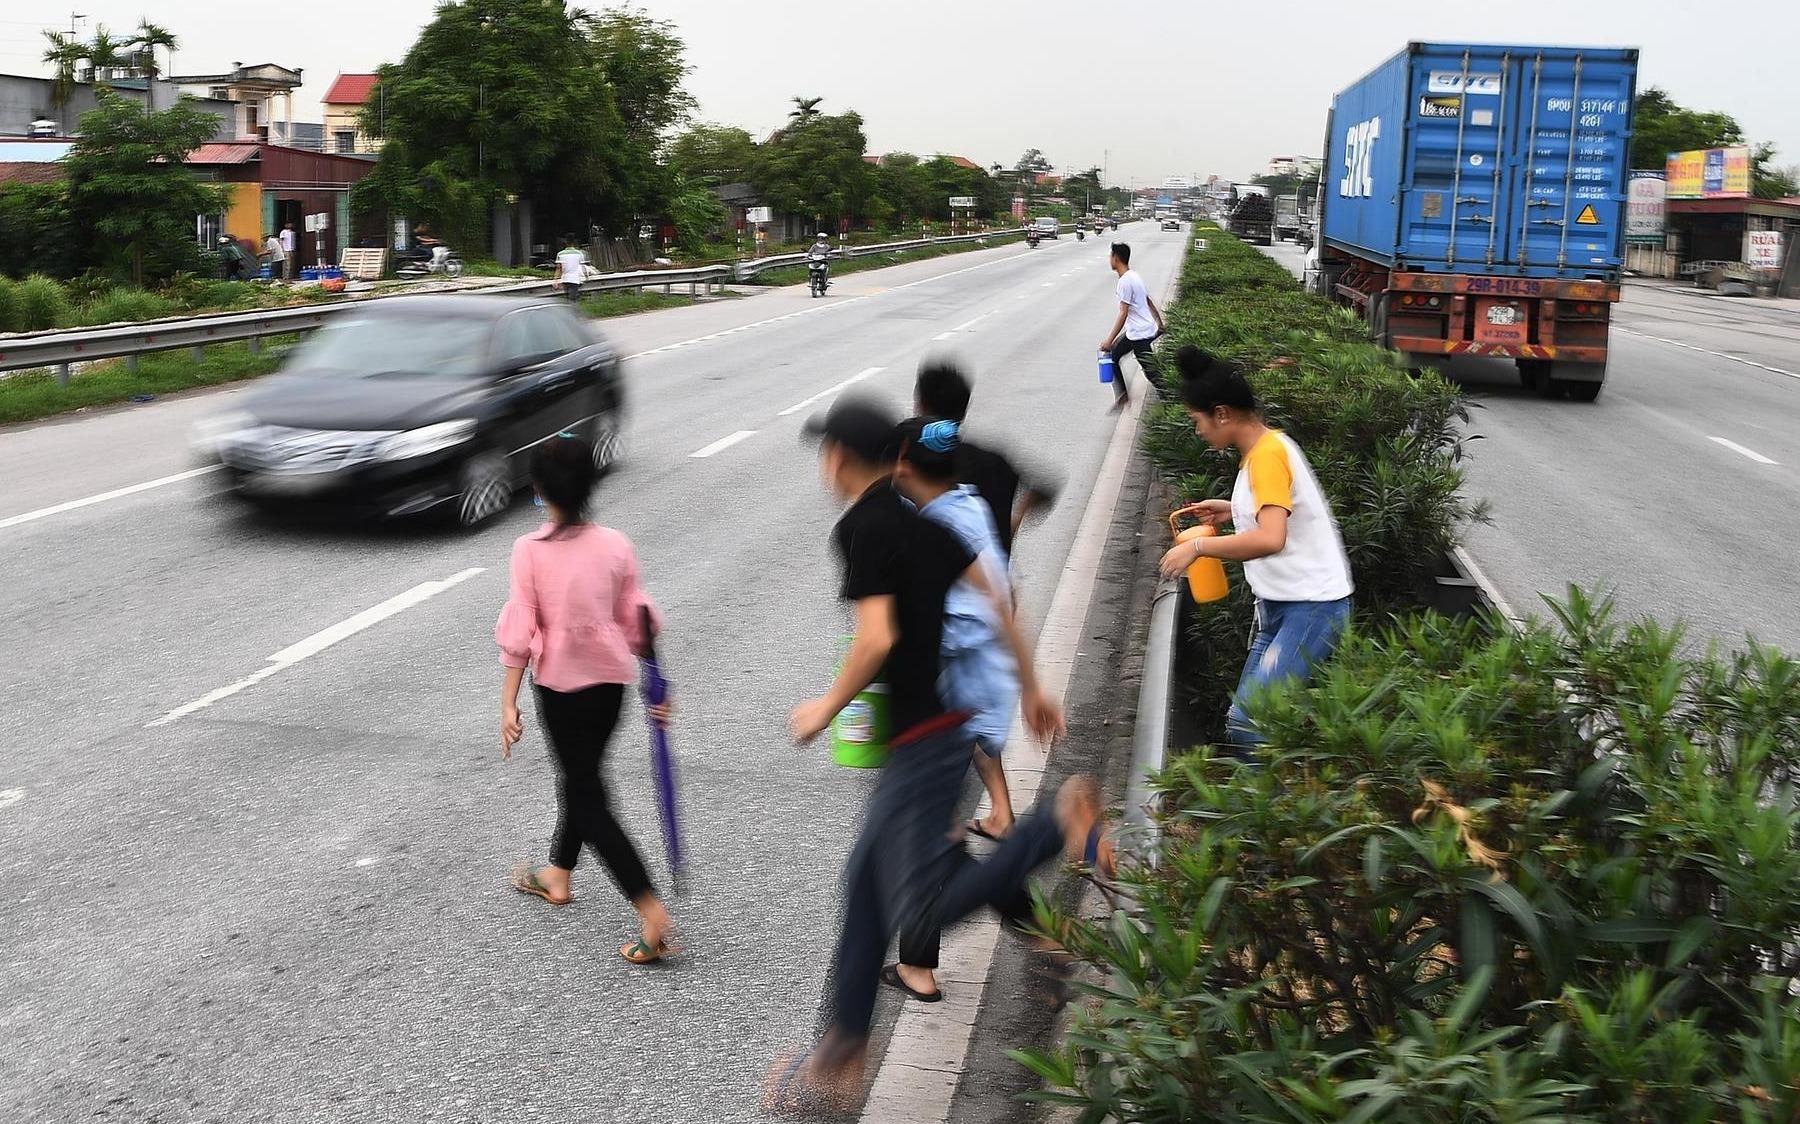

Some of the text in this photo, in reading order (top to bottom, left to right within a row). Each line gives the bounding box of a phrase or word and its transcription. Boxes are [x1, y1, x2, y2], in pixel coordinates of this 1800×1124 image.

[1547, 98, 1571, 112] BMOU
[1580, 99, 1613, 113] 317144
[1580, 115, 1601, 127] 42G1
[1756, 248, 1771, 257] XE
